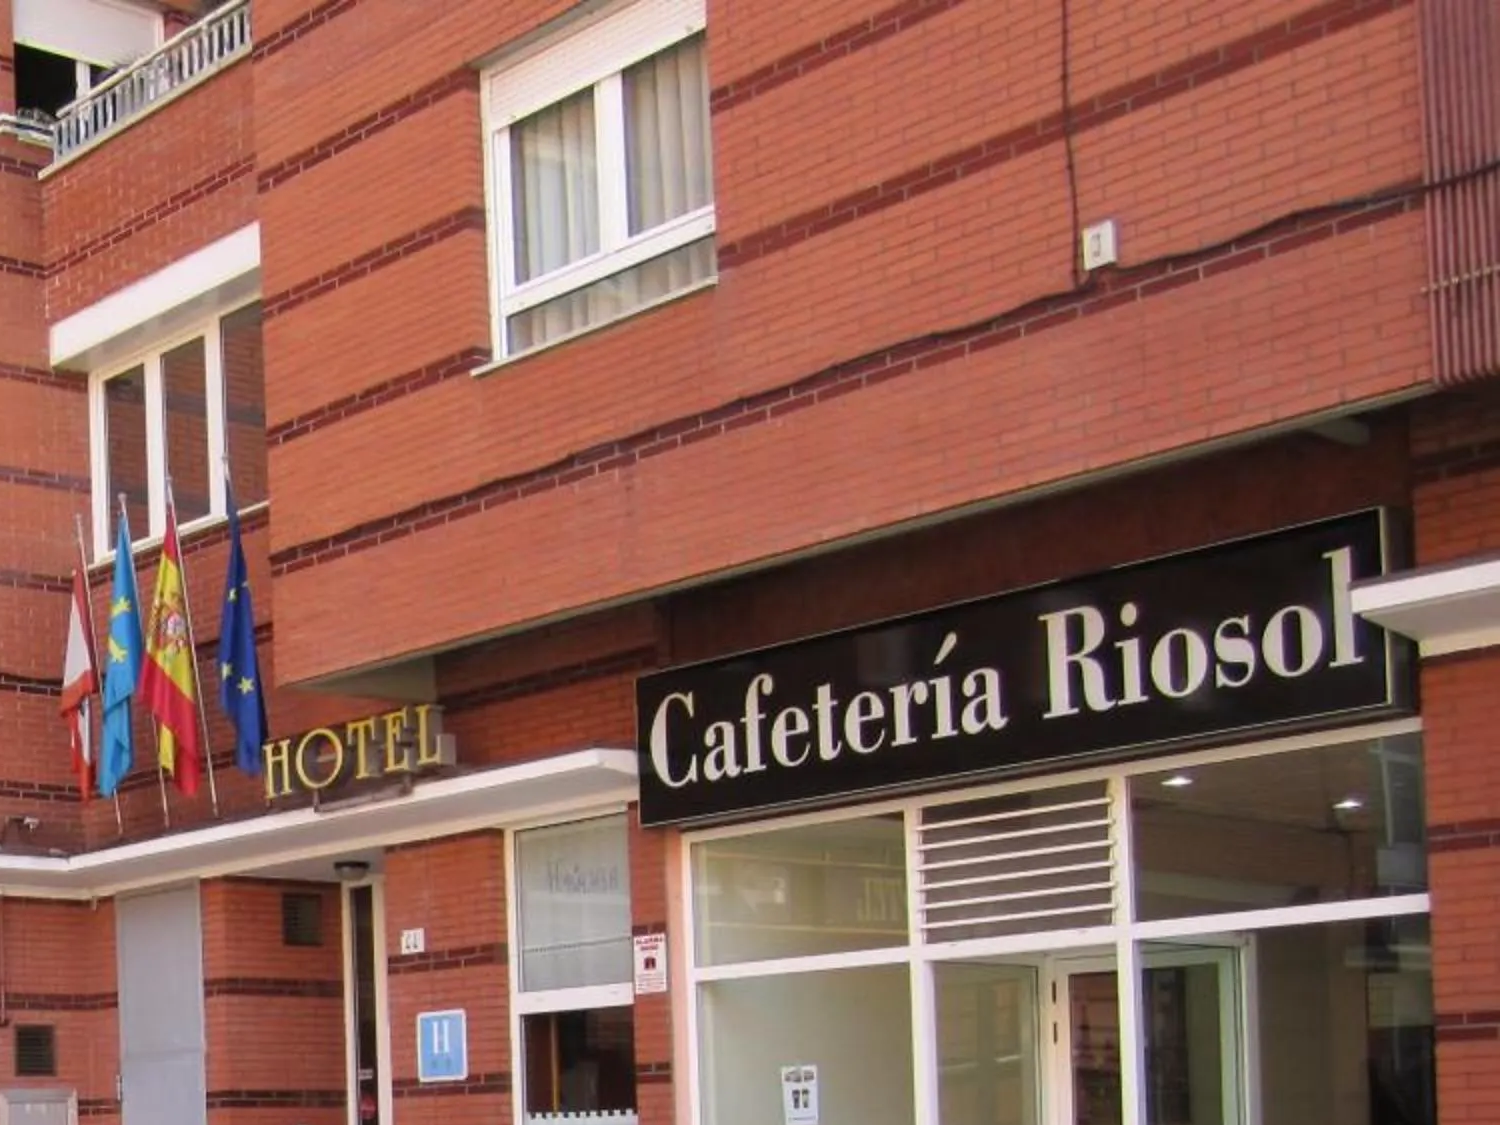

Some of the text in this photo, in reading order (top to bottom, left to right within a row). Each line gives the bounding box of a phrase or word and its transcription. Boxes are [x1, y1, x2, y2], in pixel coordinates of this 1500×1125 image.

[263, 703, 442, 799] HOTEL
[649, 546, 1365, 788] Cafetería Riosol
